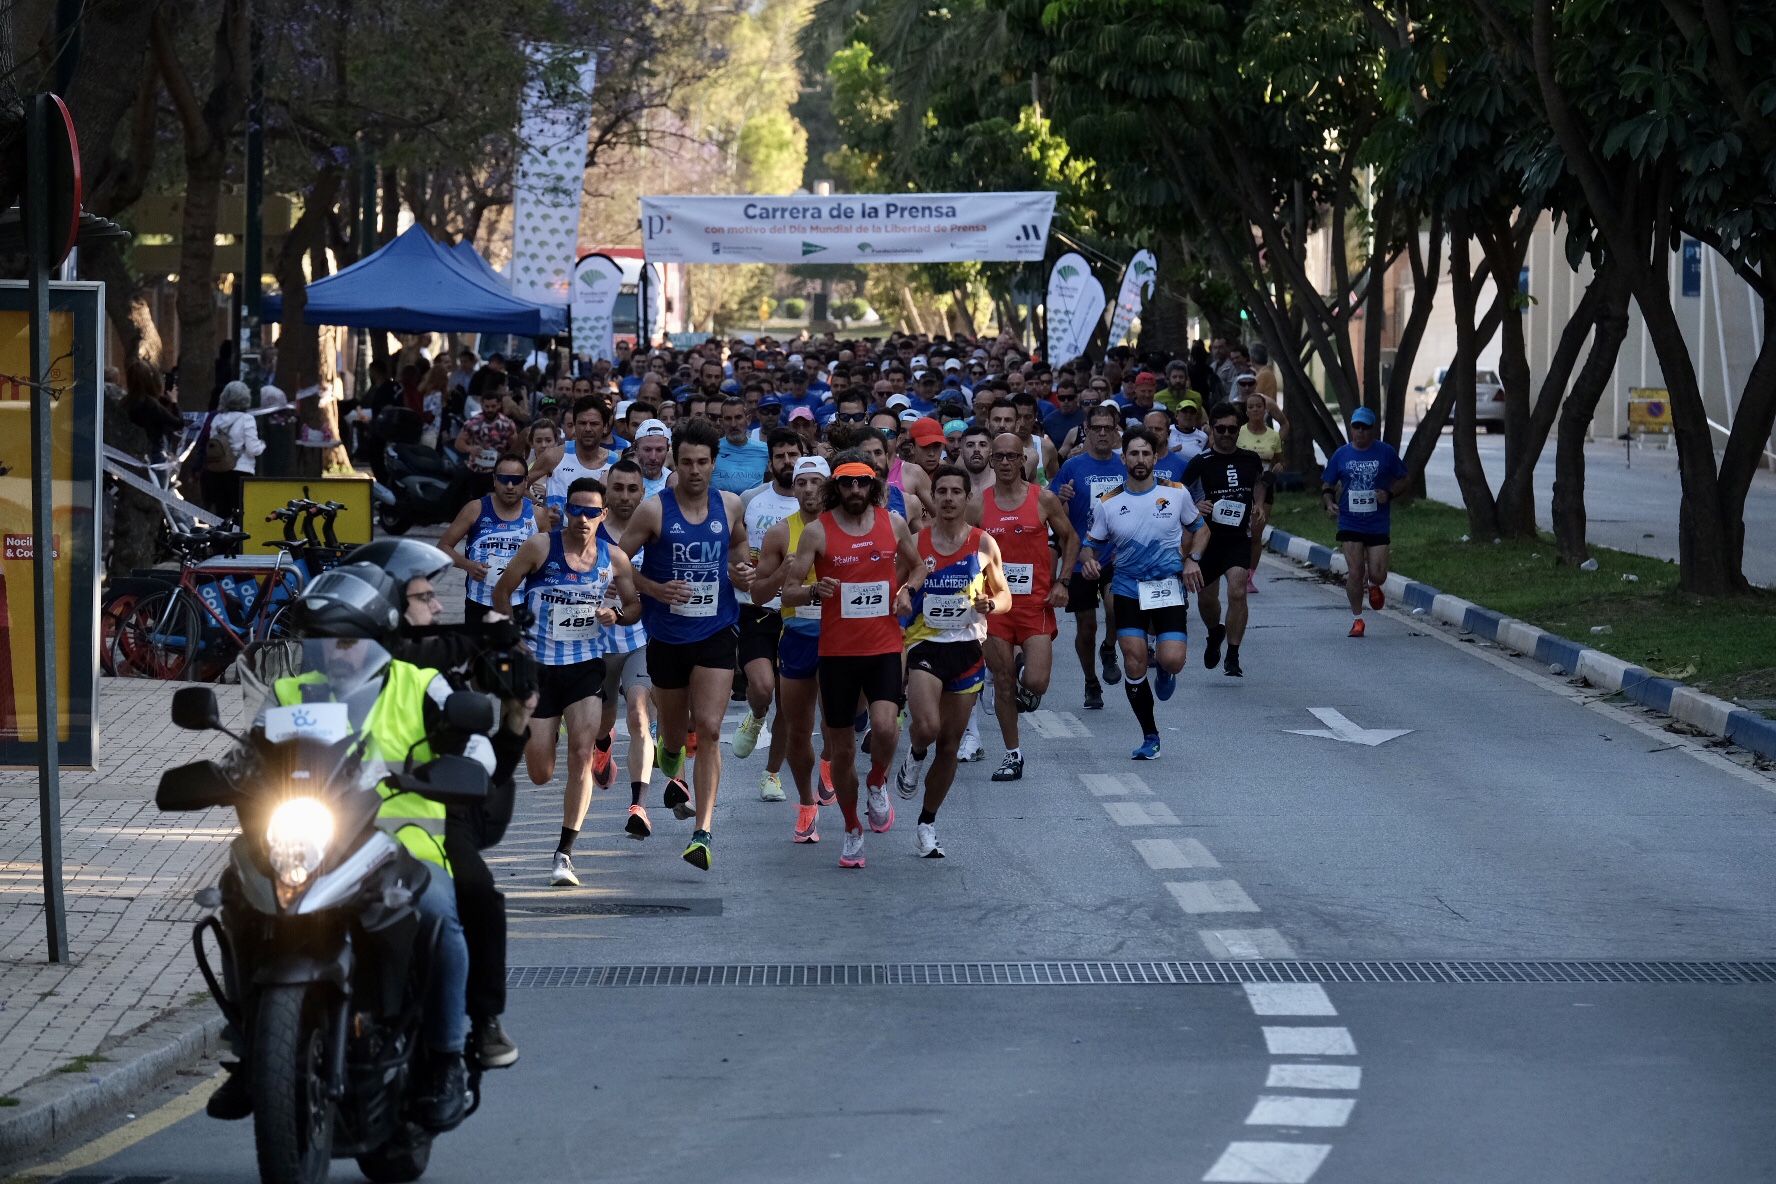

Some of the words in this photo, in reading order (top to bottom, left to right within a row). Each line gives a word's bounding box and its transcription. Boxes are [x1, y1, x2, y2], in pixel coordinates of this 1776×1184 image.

[743, 203, 822, 220] Carrera
[829, 203, 855, 219] de
[861, 202, 879, 219] la
[885, 202, 957, 219] Prensa
[704, 226, 725, 234] con
[727, 224, 766, 234] motivo
[769, 223, 787, 234] del
[809, 223, 853, 234] Mundial
[856, 223, 869, 233] de
[872, 223, 882, 233] la
[884, 223, 931, 233] Libertad
[933, 223, 947, 233] de
[950, 224, 987, 232] Prensa
[1219, 508, 1241, 518] 185
[672, 540, 722, 562] RCM
[924, 578, 969, 589] PALACIEGO
[850, 594, 883, 605] 413
[1150, 589, 1172, 599] 39
[929, 607, 968, 618] 257
[558, 616, 595, 627] 485
